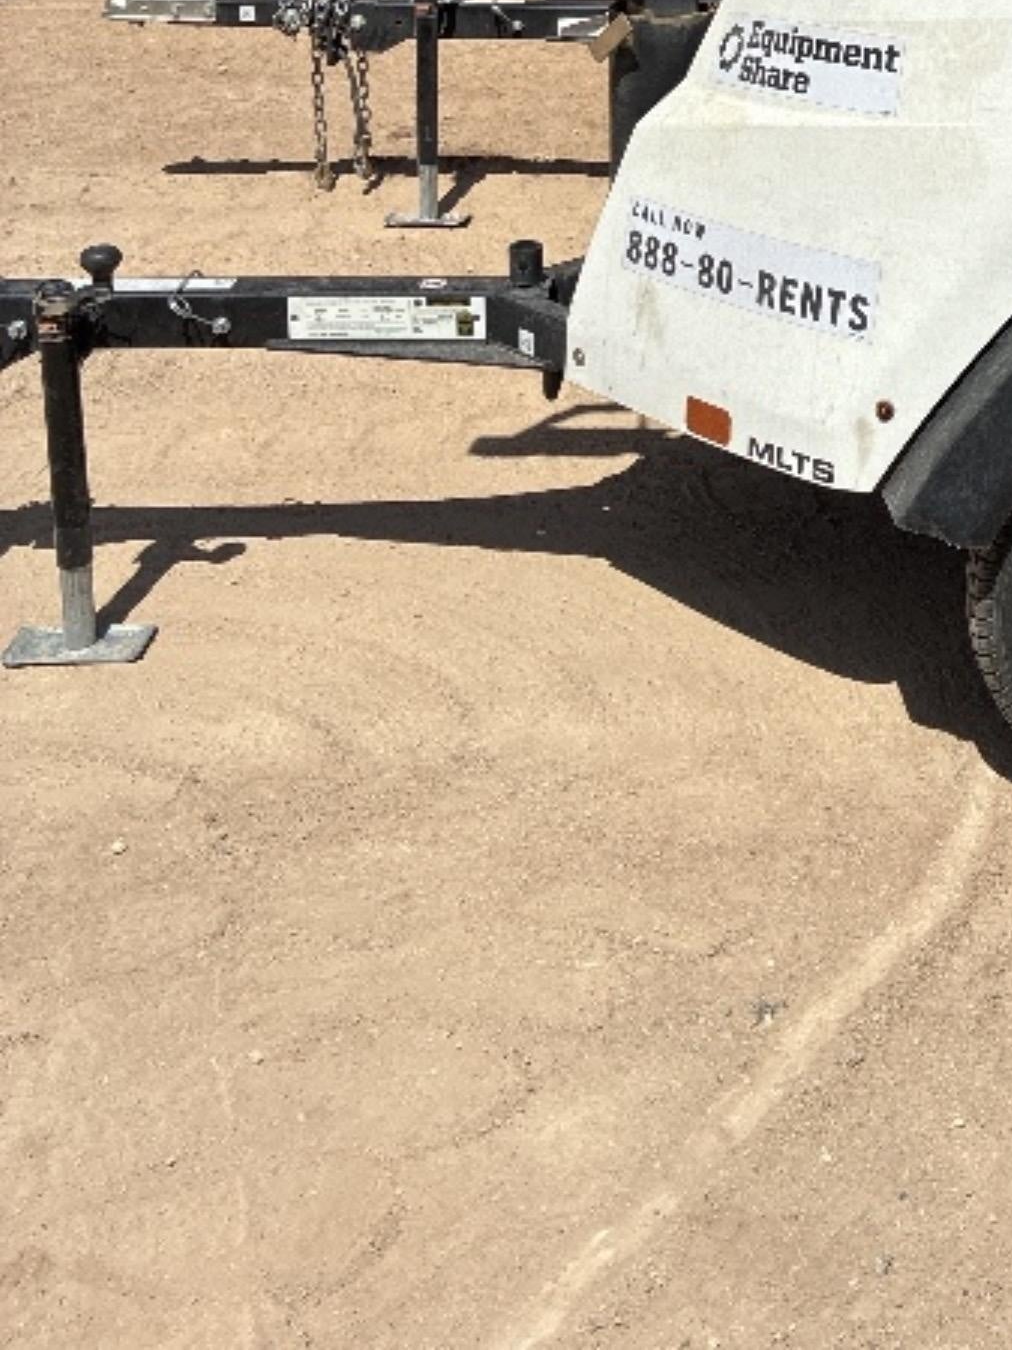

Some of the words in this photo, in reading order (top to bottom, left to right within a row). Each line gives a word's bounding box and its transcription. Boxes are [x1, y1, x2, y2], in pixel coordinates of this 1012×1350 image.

[746, 19, 901, 73] Equipment
[738, 55, 811, 94] Share
[632, 201, 665, 227] CALL
[671, 215, 706, 240] NOW
[626, 230, 870, 332] 888-80-RENTS
[745, 436, 836, 484] MLTS
